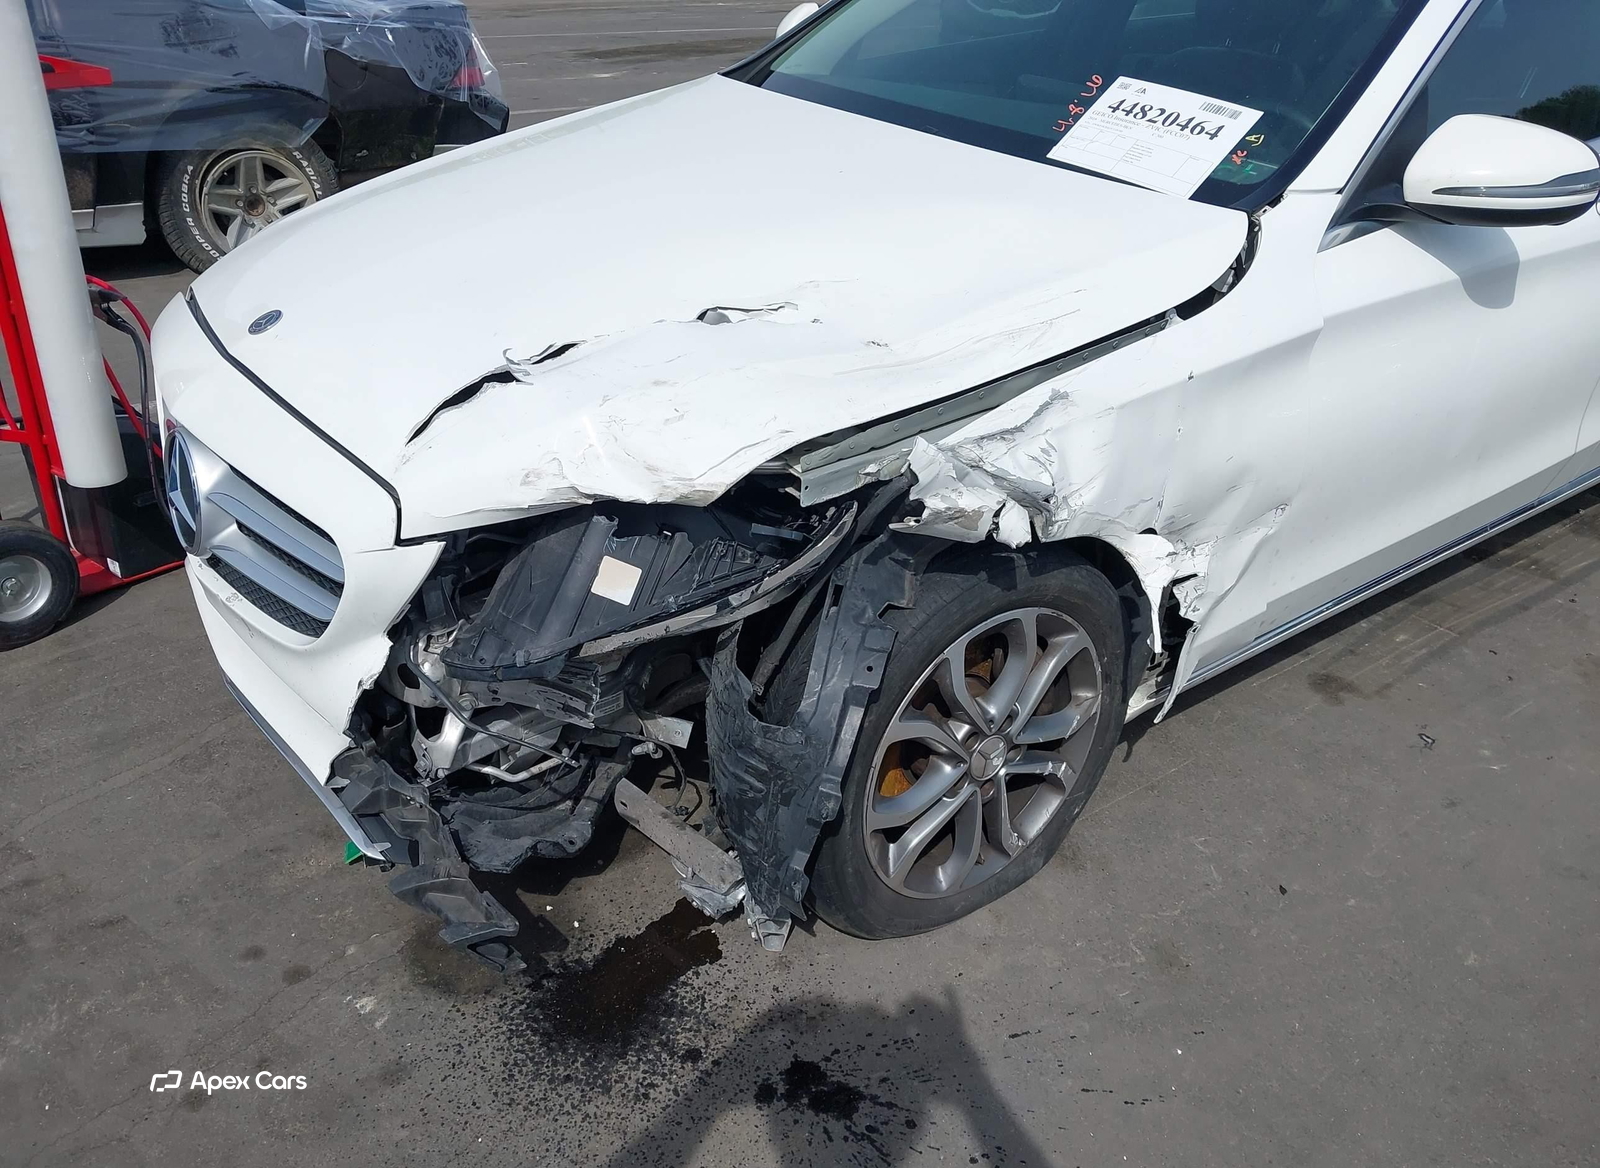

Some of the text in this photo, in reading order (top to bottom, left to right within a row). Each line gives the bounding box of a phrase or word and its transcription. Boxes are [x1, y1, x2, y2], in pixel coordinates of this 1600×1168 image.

[1091, 109, 1117, 120] GEICO
[1113, 114, 1142, 127] Insurance
[1107, 98, 1226, 141] 44820464
[180, 164, 194, 213] COBRA
[292, 151, 323, 197] RADIAL
